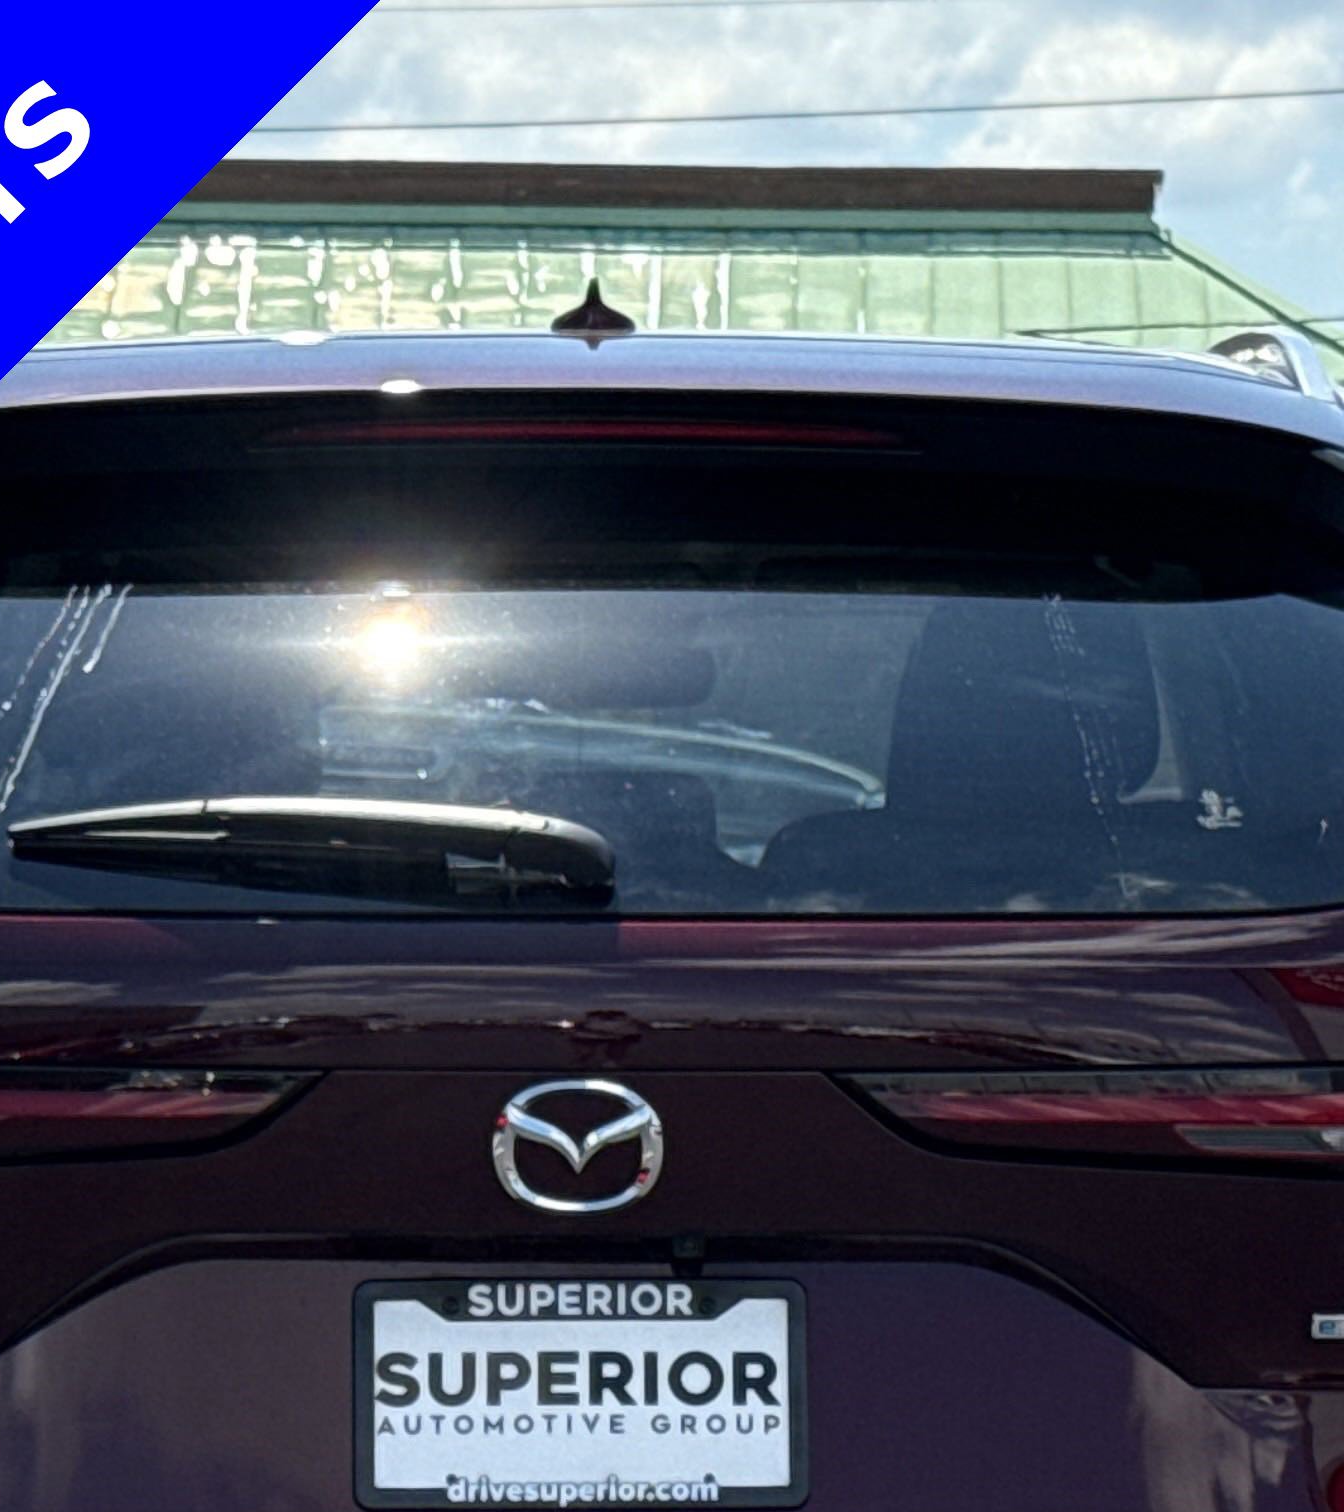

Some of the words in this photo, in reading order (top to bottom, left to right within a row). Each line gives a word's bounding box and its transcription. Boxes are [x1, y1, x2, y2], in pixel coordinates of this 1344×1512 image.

[467, 1283, 693, 1317] SUPERIOR
[374, 1351, 782, 1408] SUPERIOR
[378, 1414, 627, 1435] AUTOMOTIVE
[650, 1414, 782, 1435] GROUP
[447, 1474, 719, 1508] drivesuperior.com
